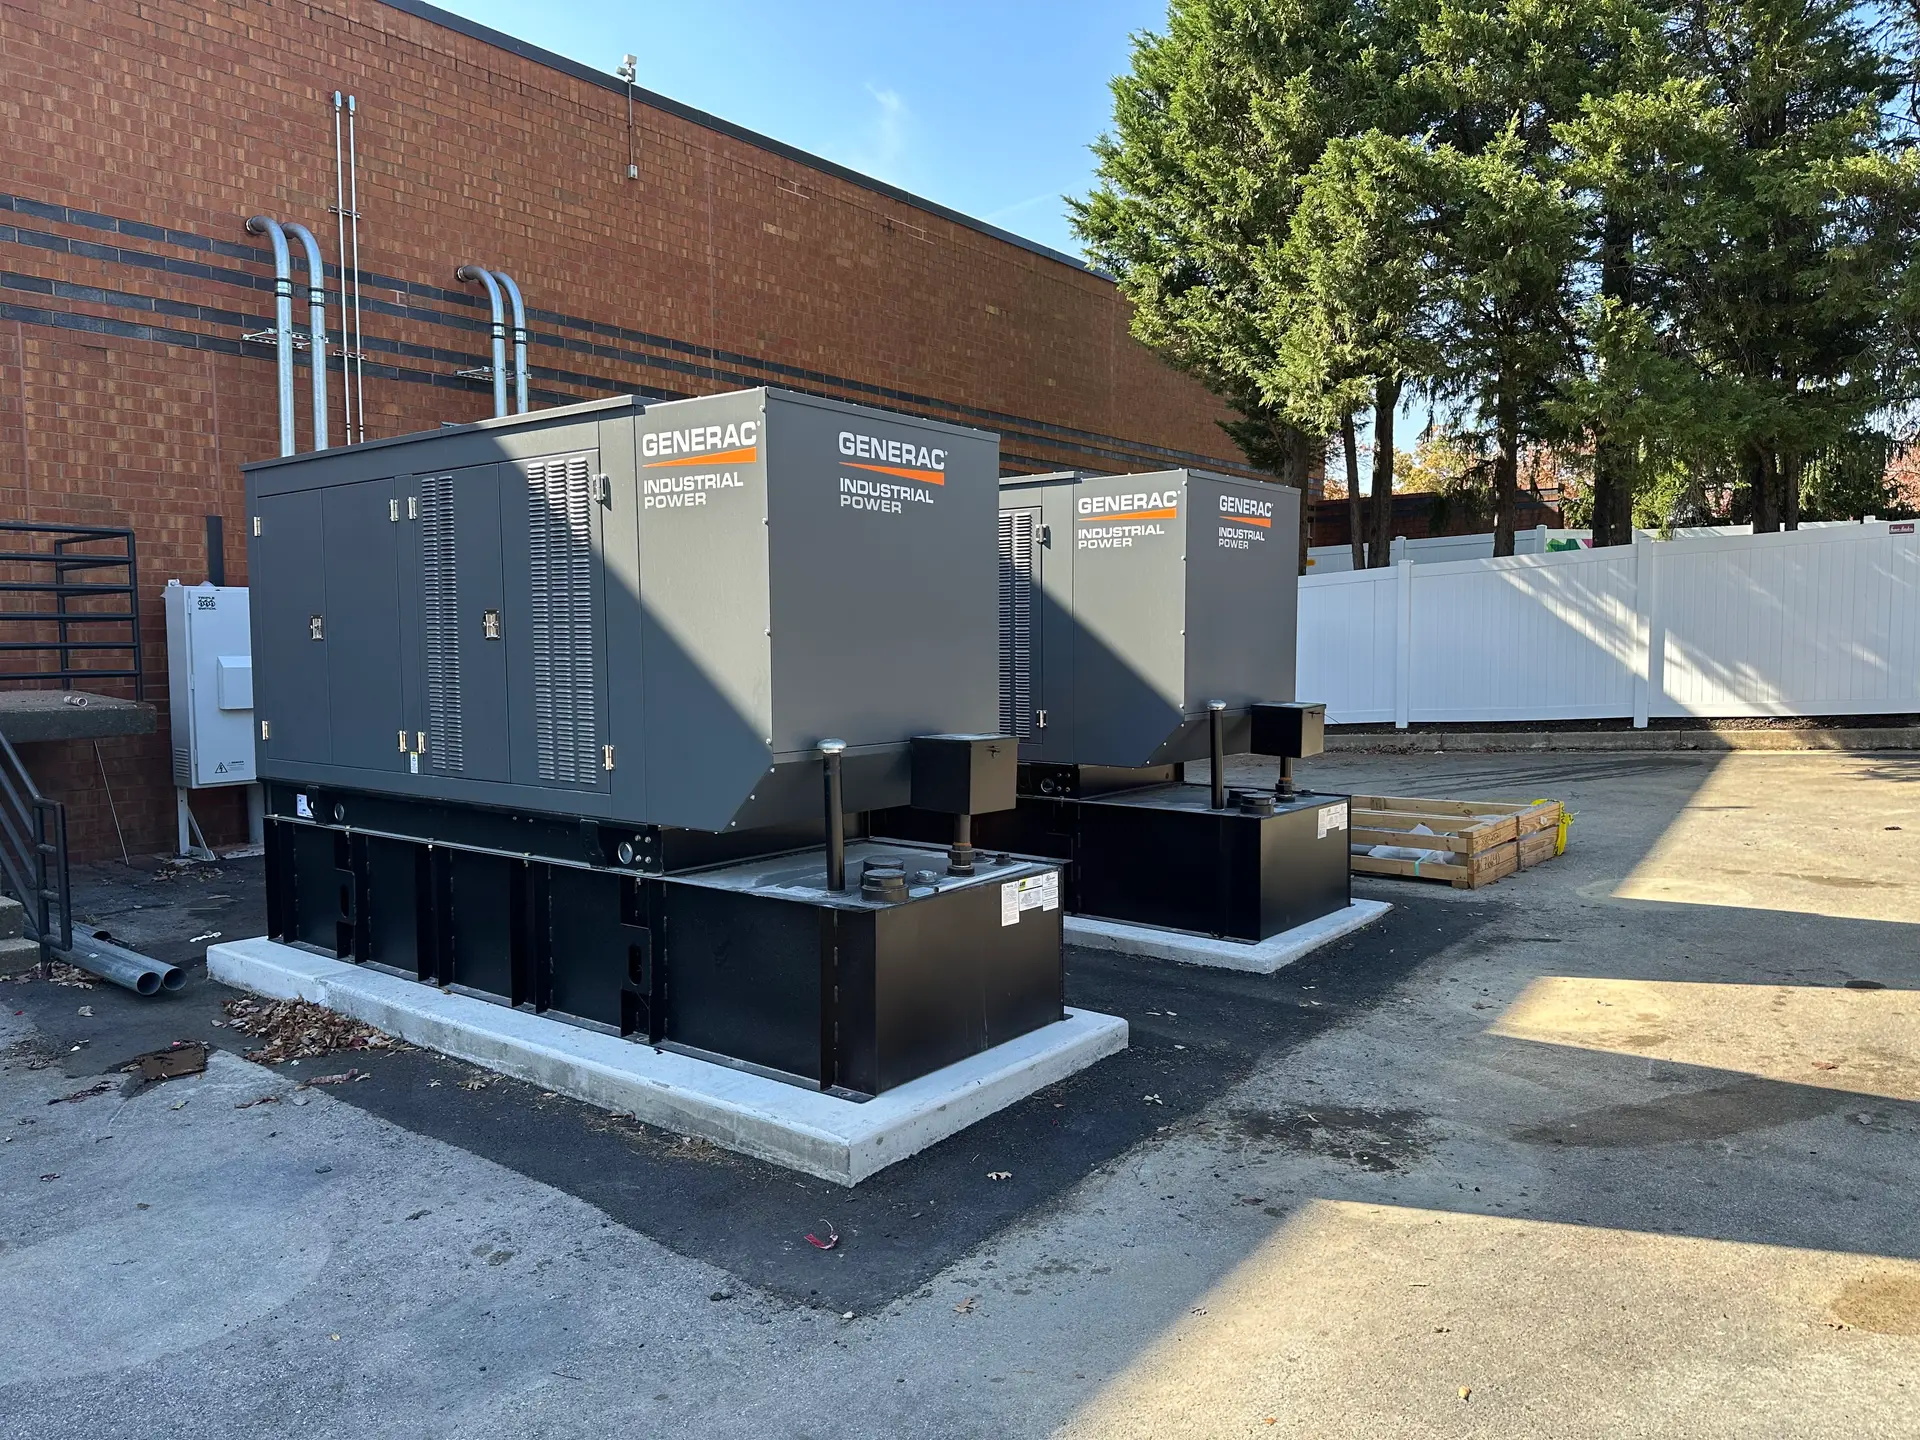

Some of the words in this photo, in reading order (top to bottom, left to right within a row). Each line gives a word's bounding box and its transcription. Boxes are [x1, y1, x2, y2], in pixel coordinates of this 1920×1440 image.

[642, 421, 757, 457] GENERAC
[838, 431, 945, 470] GENERAC
[643, 471, 744, 495] INDUSTRIAL
[839, 477, 934, 504] INDUSTRIAL
[644, 492, 707, 510] POWER
[840, 495, 902, 514] POWER
[1078, 491, 1178, 514] GENERAC
[1219, 495, 1272, 518] GENERAC
[1078, 524, 1165, 539] INDUSTRIAL
[1218, 526, 1265, 542] INDUSTRIAL
[1078, 537, 1133, 550] POWER
[1218, 539, 1249, 550] POWER
